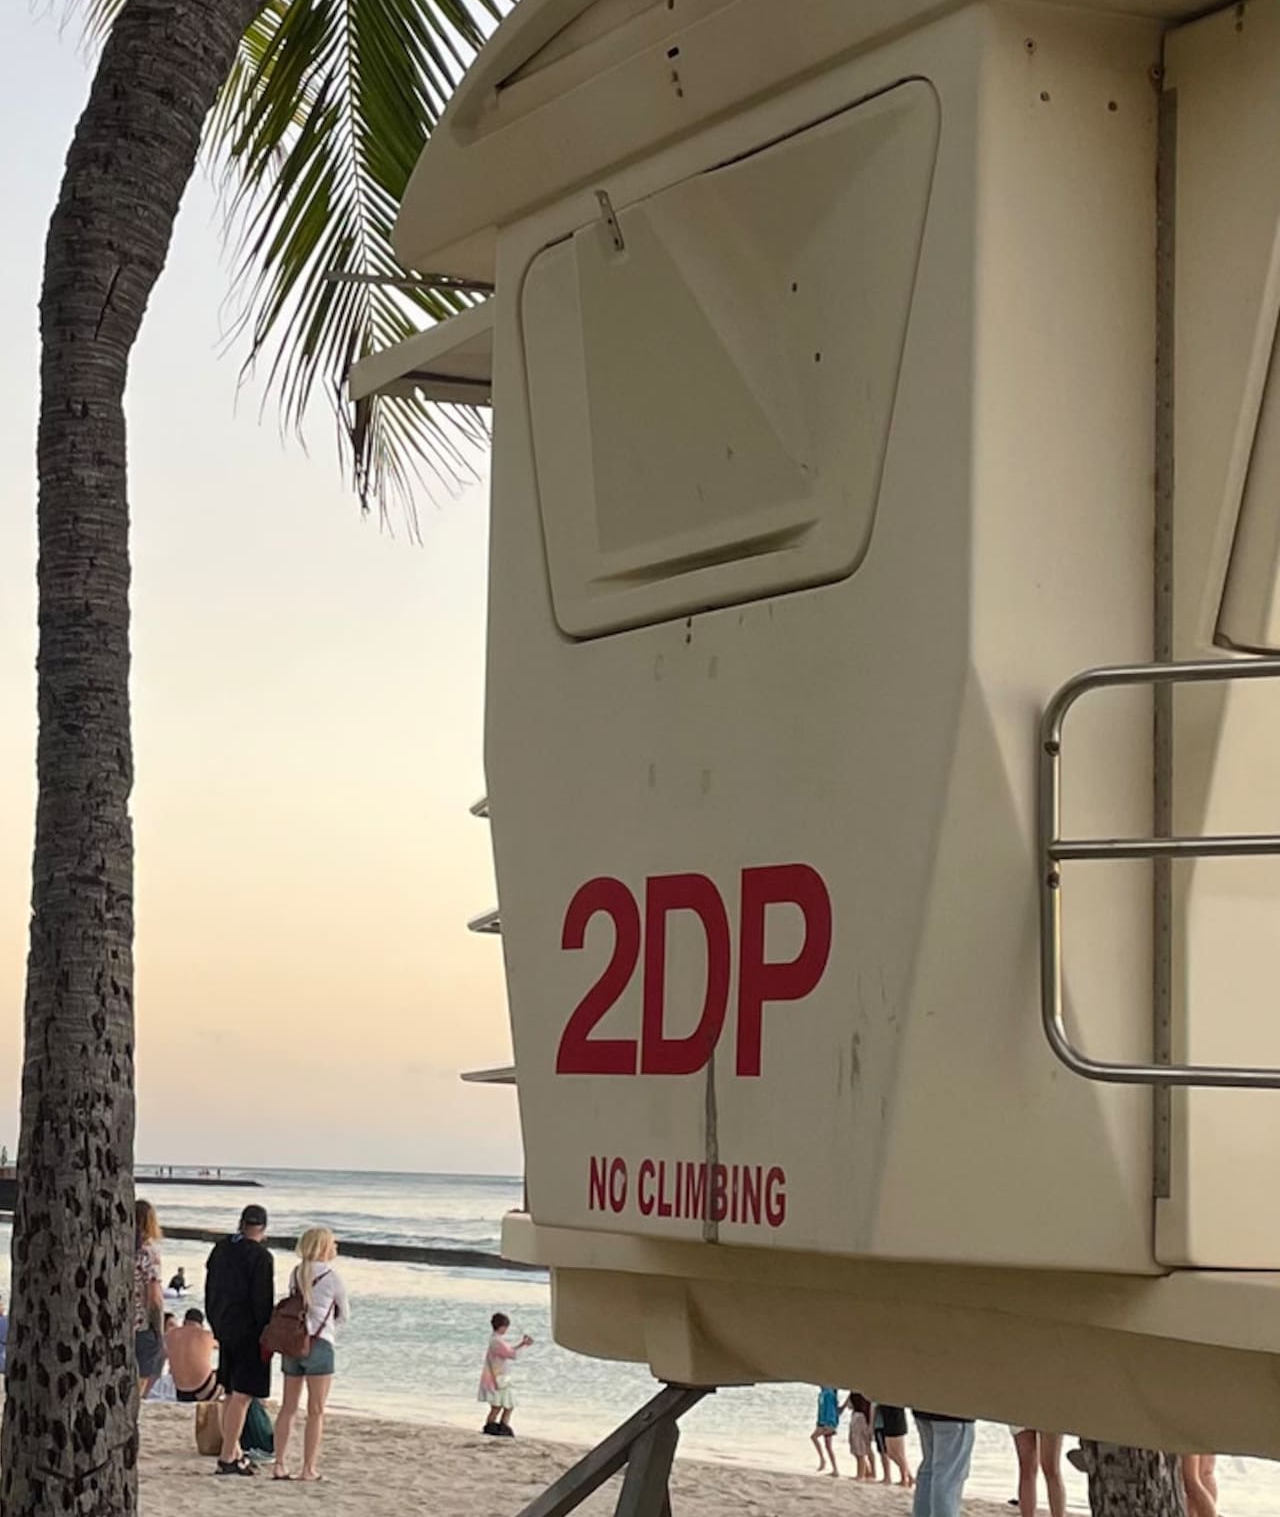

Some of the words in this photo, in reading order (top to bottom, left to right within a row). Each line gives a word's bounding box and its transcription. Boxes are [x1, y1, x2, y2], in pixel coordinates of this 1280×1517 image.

[556, 863, 832, 1076] 2DP
[588, 1156, 627, 1213] NO
[638, 1158, 786, 1227] CLIMBING
